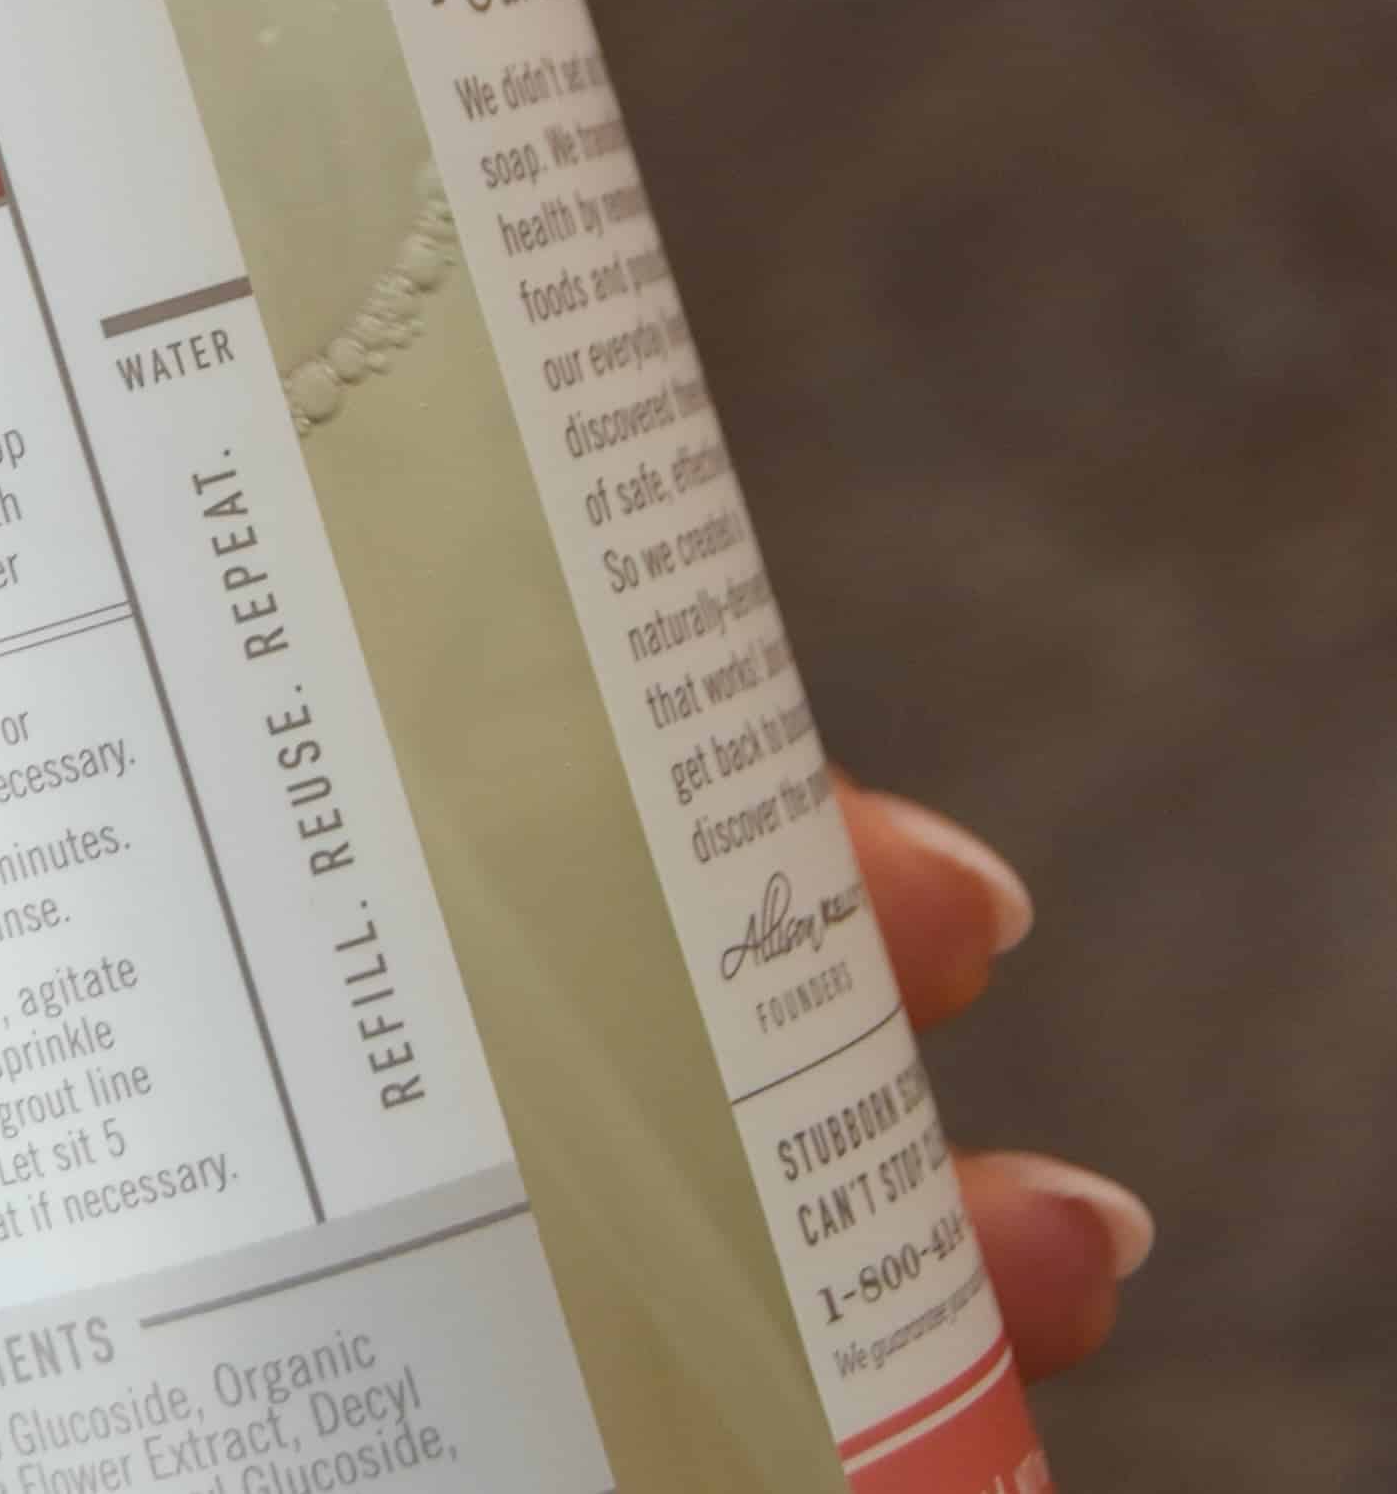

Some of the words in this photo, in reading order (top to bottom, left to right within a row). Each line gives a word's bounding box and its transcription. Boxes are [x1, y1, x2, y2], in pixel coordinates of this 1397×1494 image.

[454, 74, 499, 121] We
[480, 143, 548, 189] soap.
[496, 192, 577, 257] health
[518, 266, 589, 324] foods
[116, 329, 236, 393] WATER
[543, 349, 584, 392] our
[585, 476, 613, 528] of
[615, 460, 672, 517] safe,
[192, 446, 290, 660] REPEAT.
[604, 548, 639, 594] So
[641, 540, 676, 580] we
[646, 672, 704, 730] that
[266, 682, 355, 877] REUSE.
[671, 743, 712, 805] get
[710, 720, 762, 777] back
[692, 796, 780, 864] discover
[19, 954, 141, 1020] agitate
[334, 898, 426, 1110] REFILL.
[756, 960, 853, 1035] FOUNDERS
[85, 1064, 154, 1108] line
[51, 1127, 99, 1174] sit
[101, 1117, 129, 1159] 5
[776, 1084, 900, 1182] STUBBORN
[26, 1191, 55, 1233] if
[62, 1153, 242, 1226] necessary.
[797, 1172, 877, 1247] CAN'T
[8, 1379, 206, 1457] Glucoside,
[211, 1329, 377, 1408] Organic
[832, 1342, 868, 1379] We
[16, 1454, 133, 1494] Flower
[143, 1405, 302, 1482] Extract,
[307, 1363, 422, 1438] Decyl
[239, 1420, 458, 1494] Glucoside,
